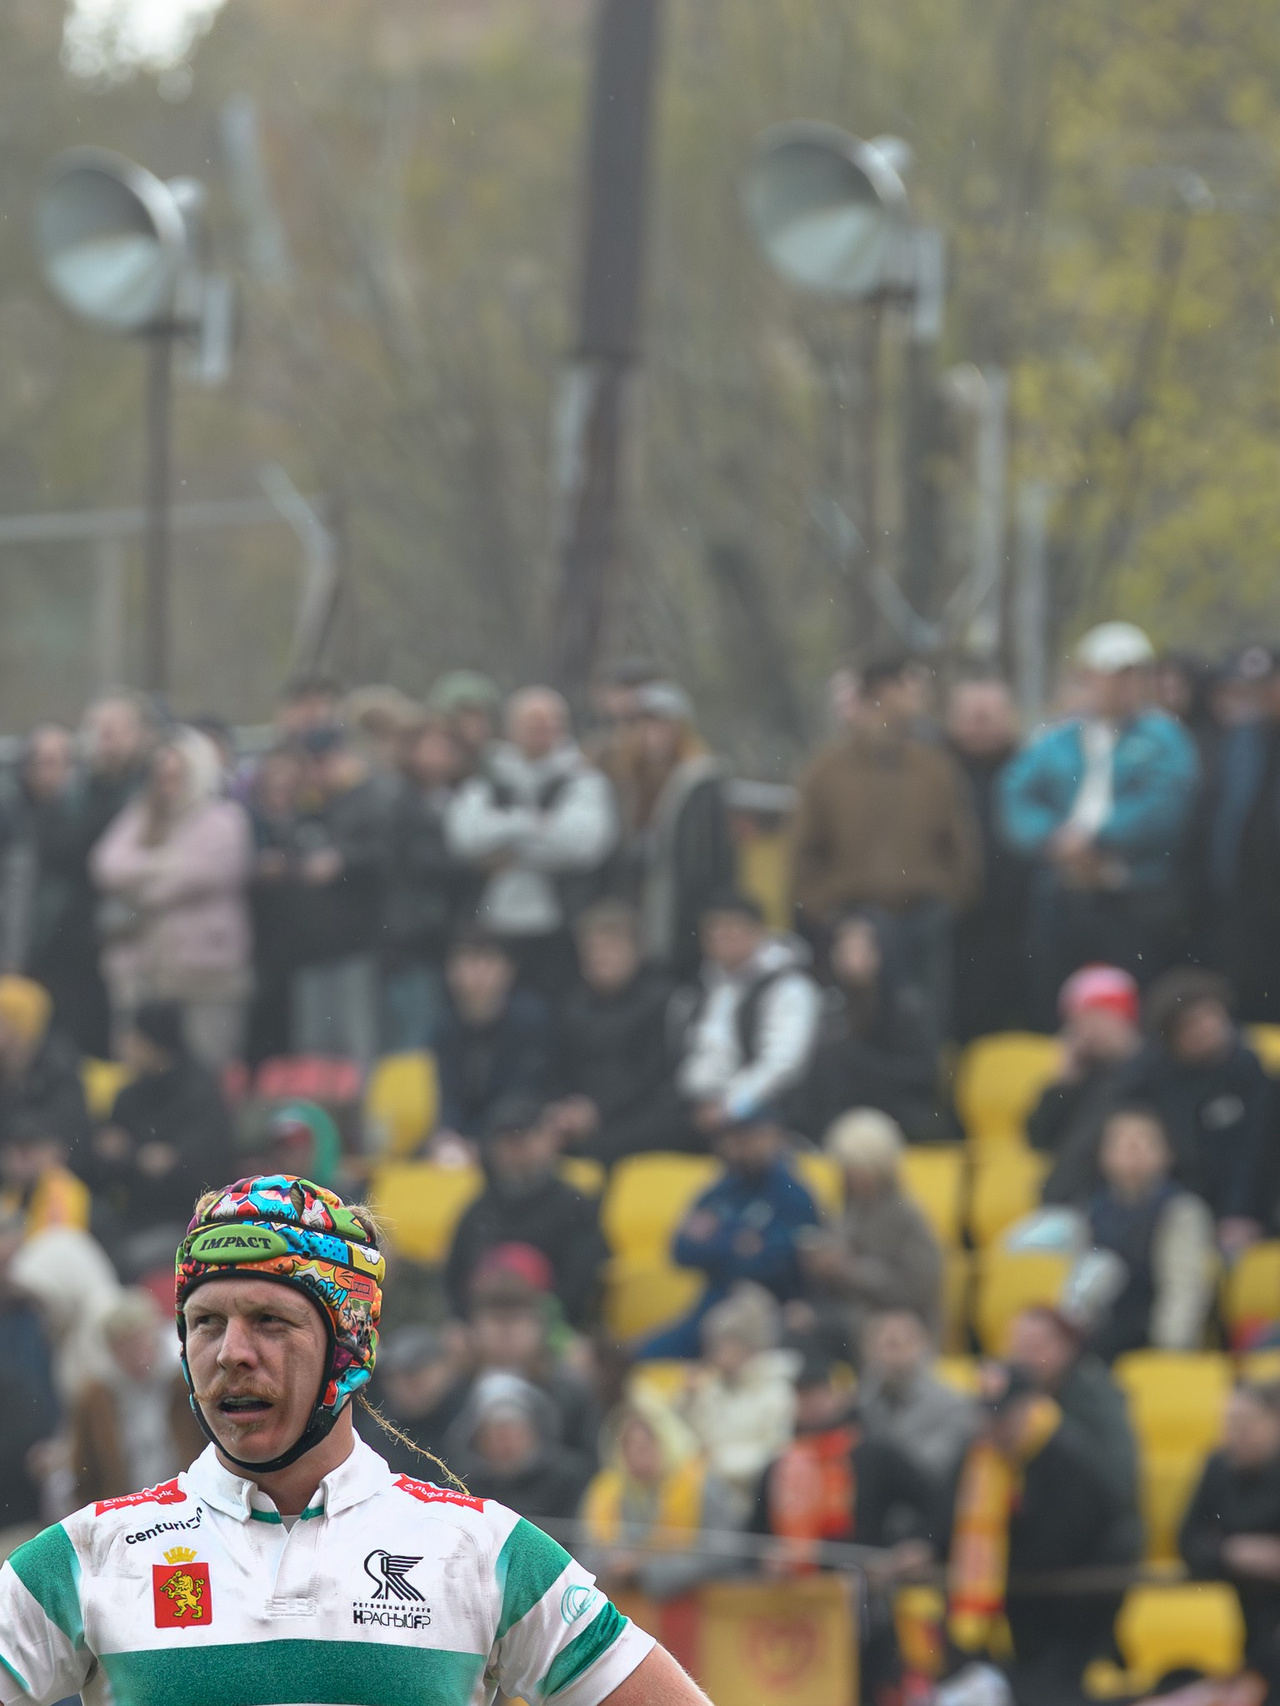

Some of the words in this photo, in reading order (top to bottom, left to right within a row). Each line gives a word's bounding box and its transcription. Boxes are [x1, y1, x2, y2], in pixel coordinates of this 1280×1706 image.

[199, 1236, 272, 1252] IMPACT
[403, 1483, 443, 1498] Альфа
[445, 1491, 477, 1503] Банк
[125, 1507, 203, 1544] centurion
